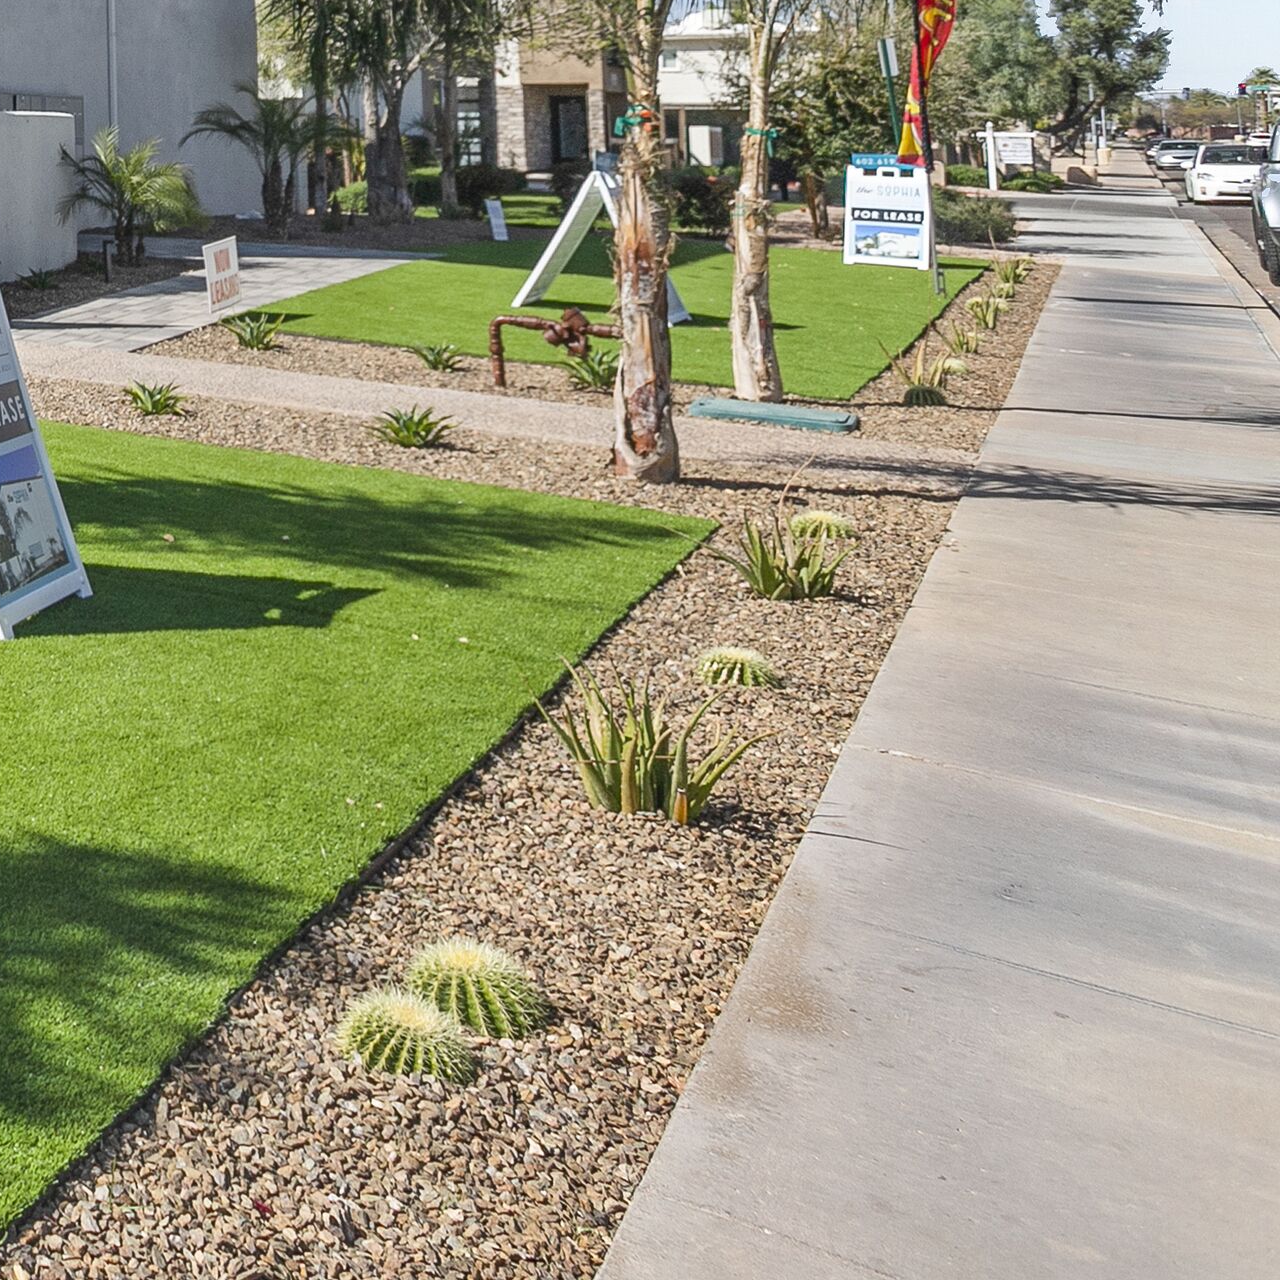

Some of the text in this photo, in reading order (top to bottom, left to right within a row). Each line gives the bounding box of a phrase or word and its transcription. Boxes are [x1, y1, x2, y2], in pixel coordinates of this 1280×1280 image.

[876, 183, 921, 198] SOPHIA
[853, 209, 922, 223] FOR LEASE
